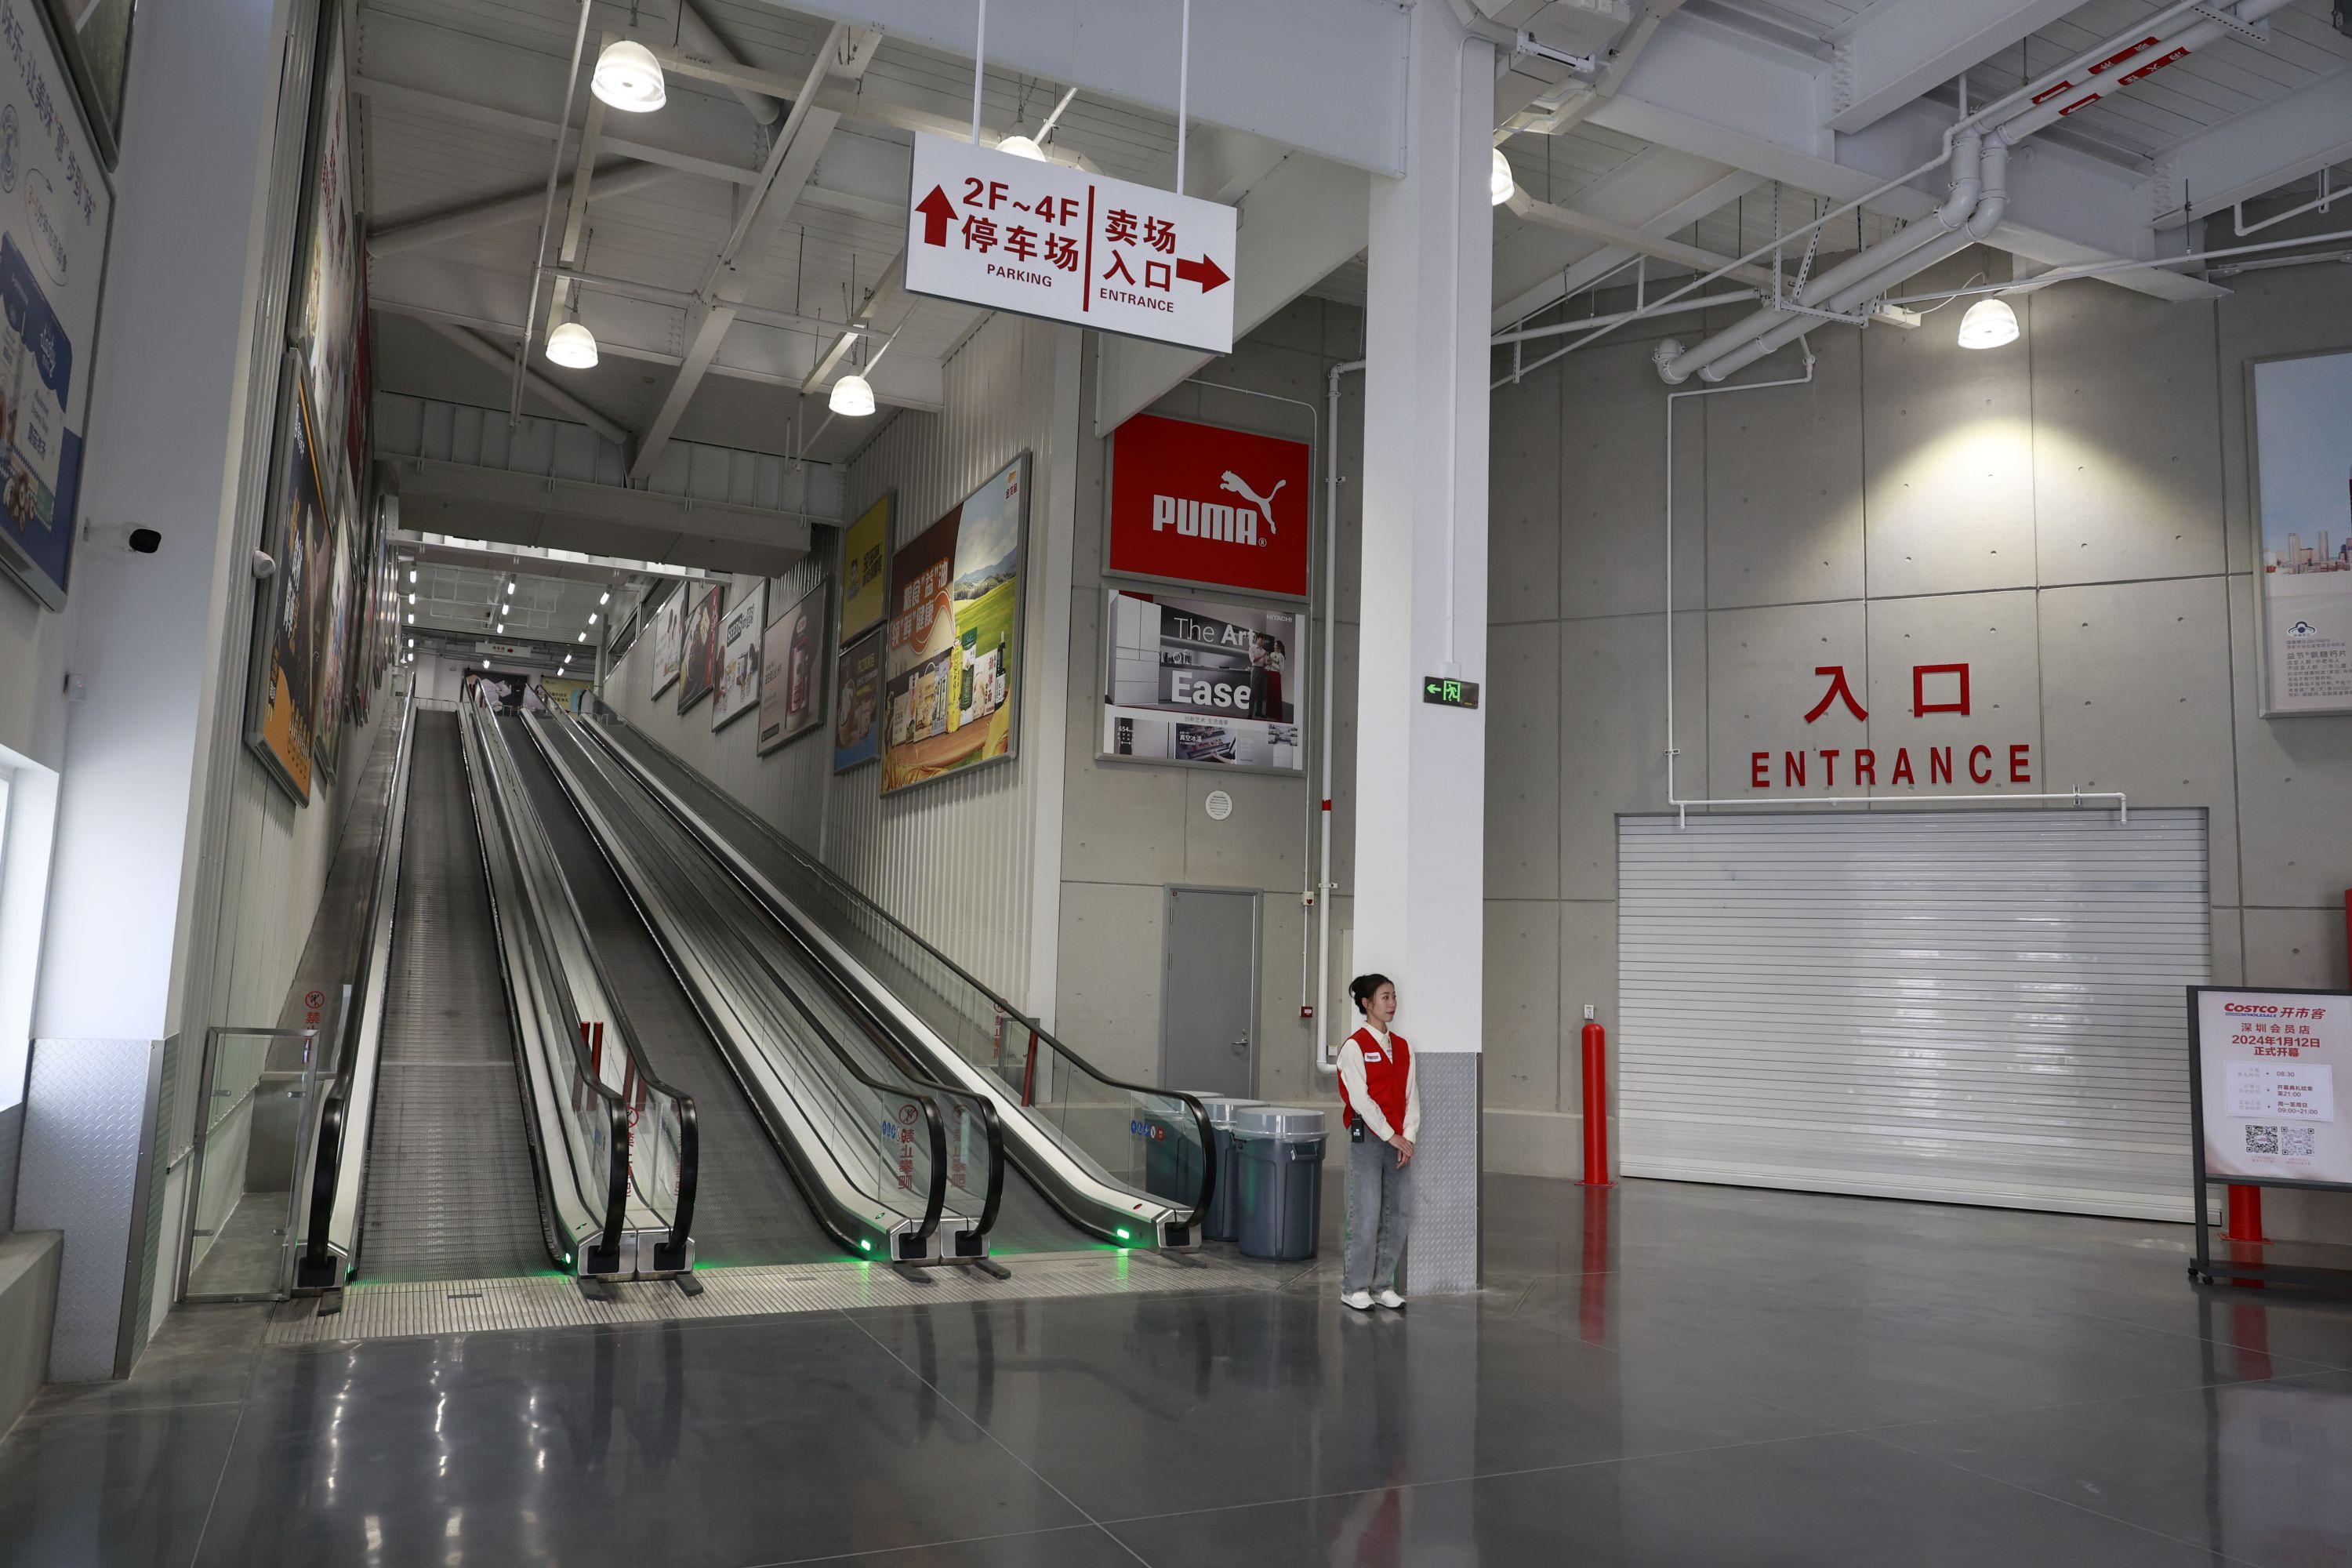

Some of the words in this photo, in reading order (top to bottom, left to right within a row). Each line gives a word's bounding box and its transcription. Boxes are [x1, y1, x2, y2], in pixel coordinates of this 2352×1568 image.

[961, 176, 1080, 227] 2F~4F
[961, 214, 1079, 272] 停车场
[1104, 209, 1176, 255] 卖场
[986, 263, 1052, 288] PARKING
[1102, 249, 1171, 292] 入口
[1100, 288, 1174, 313] ENTRANCE
[1152, 494, 1258, 546] PUMA
[1174, 617, 1215, 642] The
[1221, 624, 1256, 646] Art
[1266, 614, 1293, 623] HITACHI
[1172, 649, 1191, 665] of
[1171, 670, 1251, 710] Ease
[1804, 662, 1970, 724] 入口
[1751, 744, 2031, 788] ENTRANCE
[2280, 1007, 2326, 1020] 开市客
[2232, 1035, 2321, 1047] 2024年1月12日
[2241, 1022, 2310, 1035] 深圳会员店
[2254, 1046, 2299, 1058] 正式开幕
